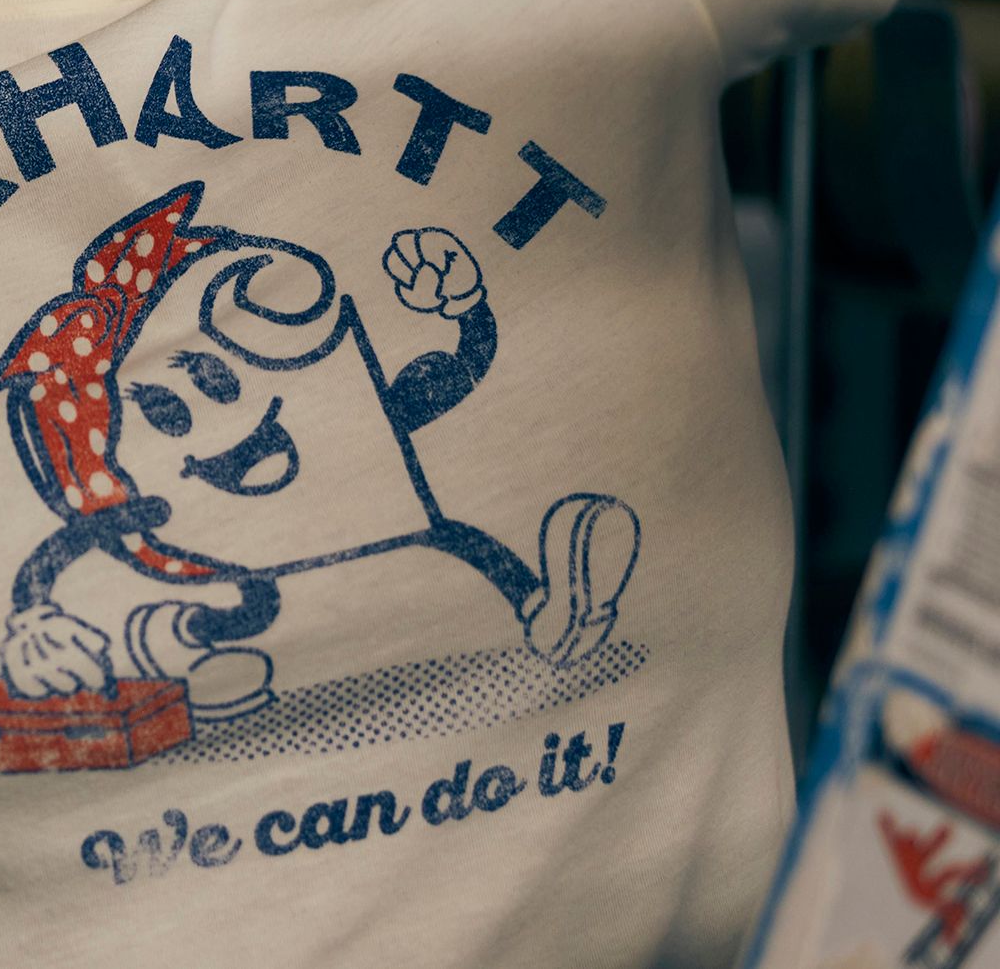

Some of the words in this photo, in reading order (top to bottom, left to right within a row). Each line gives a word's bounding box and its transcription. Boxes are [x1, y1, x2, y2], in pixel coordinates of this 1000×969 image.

[80, 809, 242, 885] We
[255, 790, 411, 856] can
[422, 759, 527, 826] do
[538, 722, 625, 796] it!
